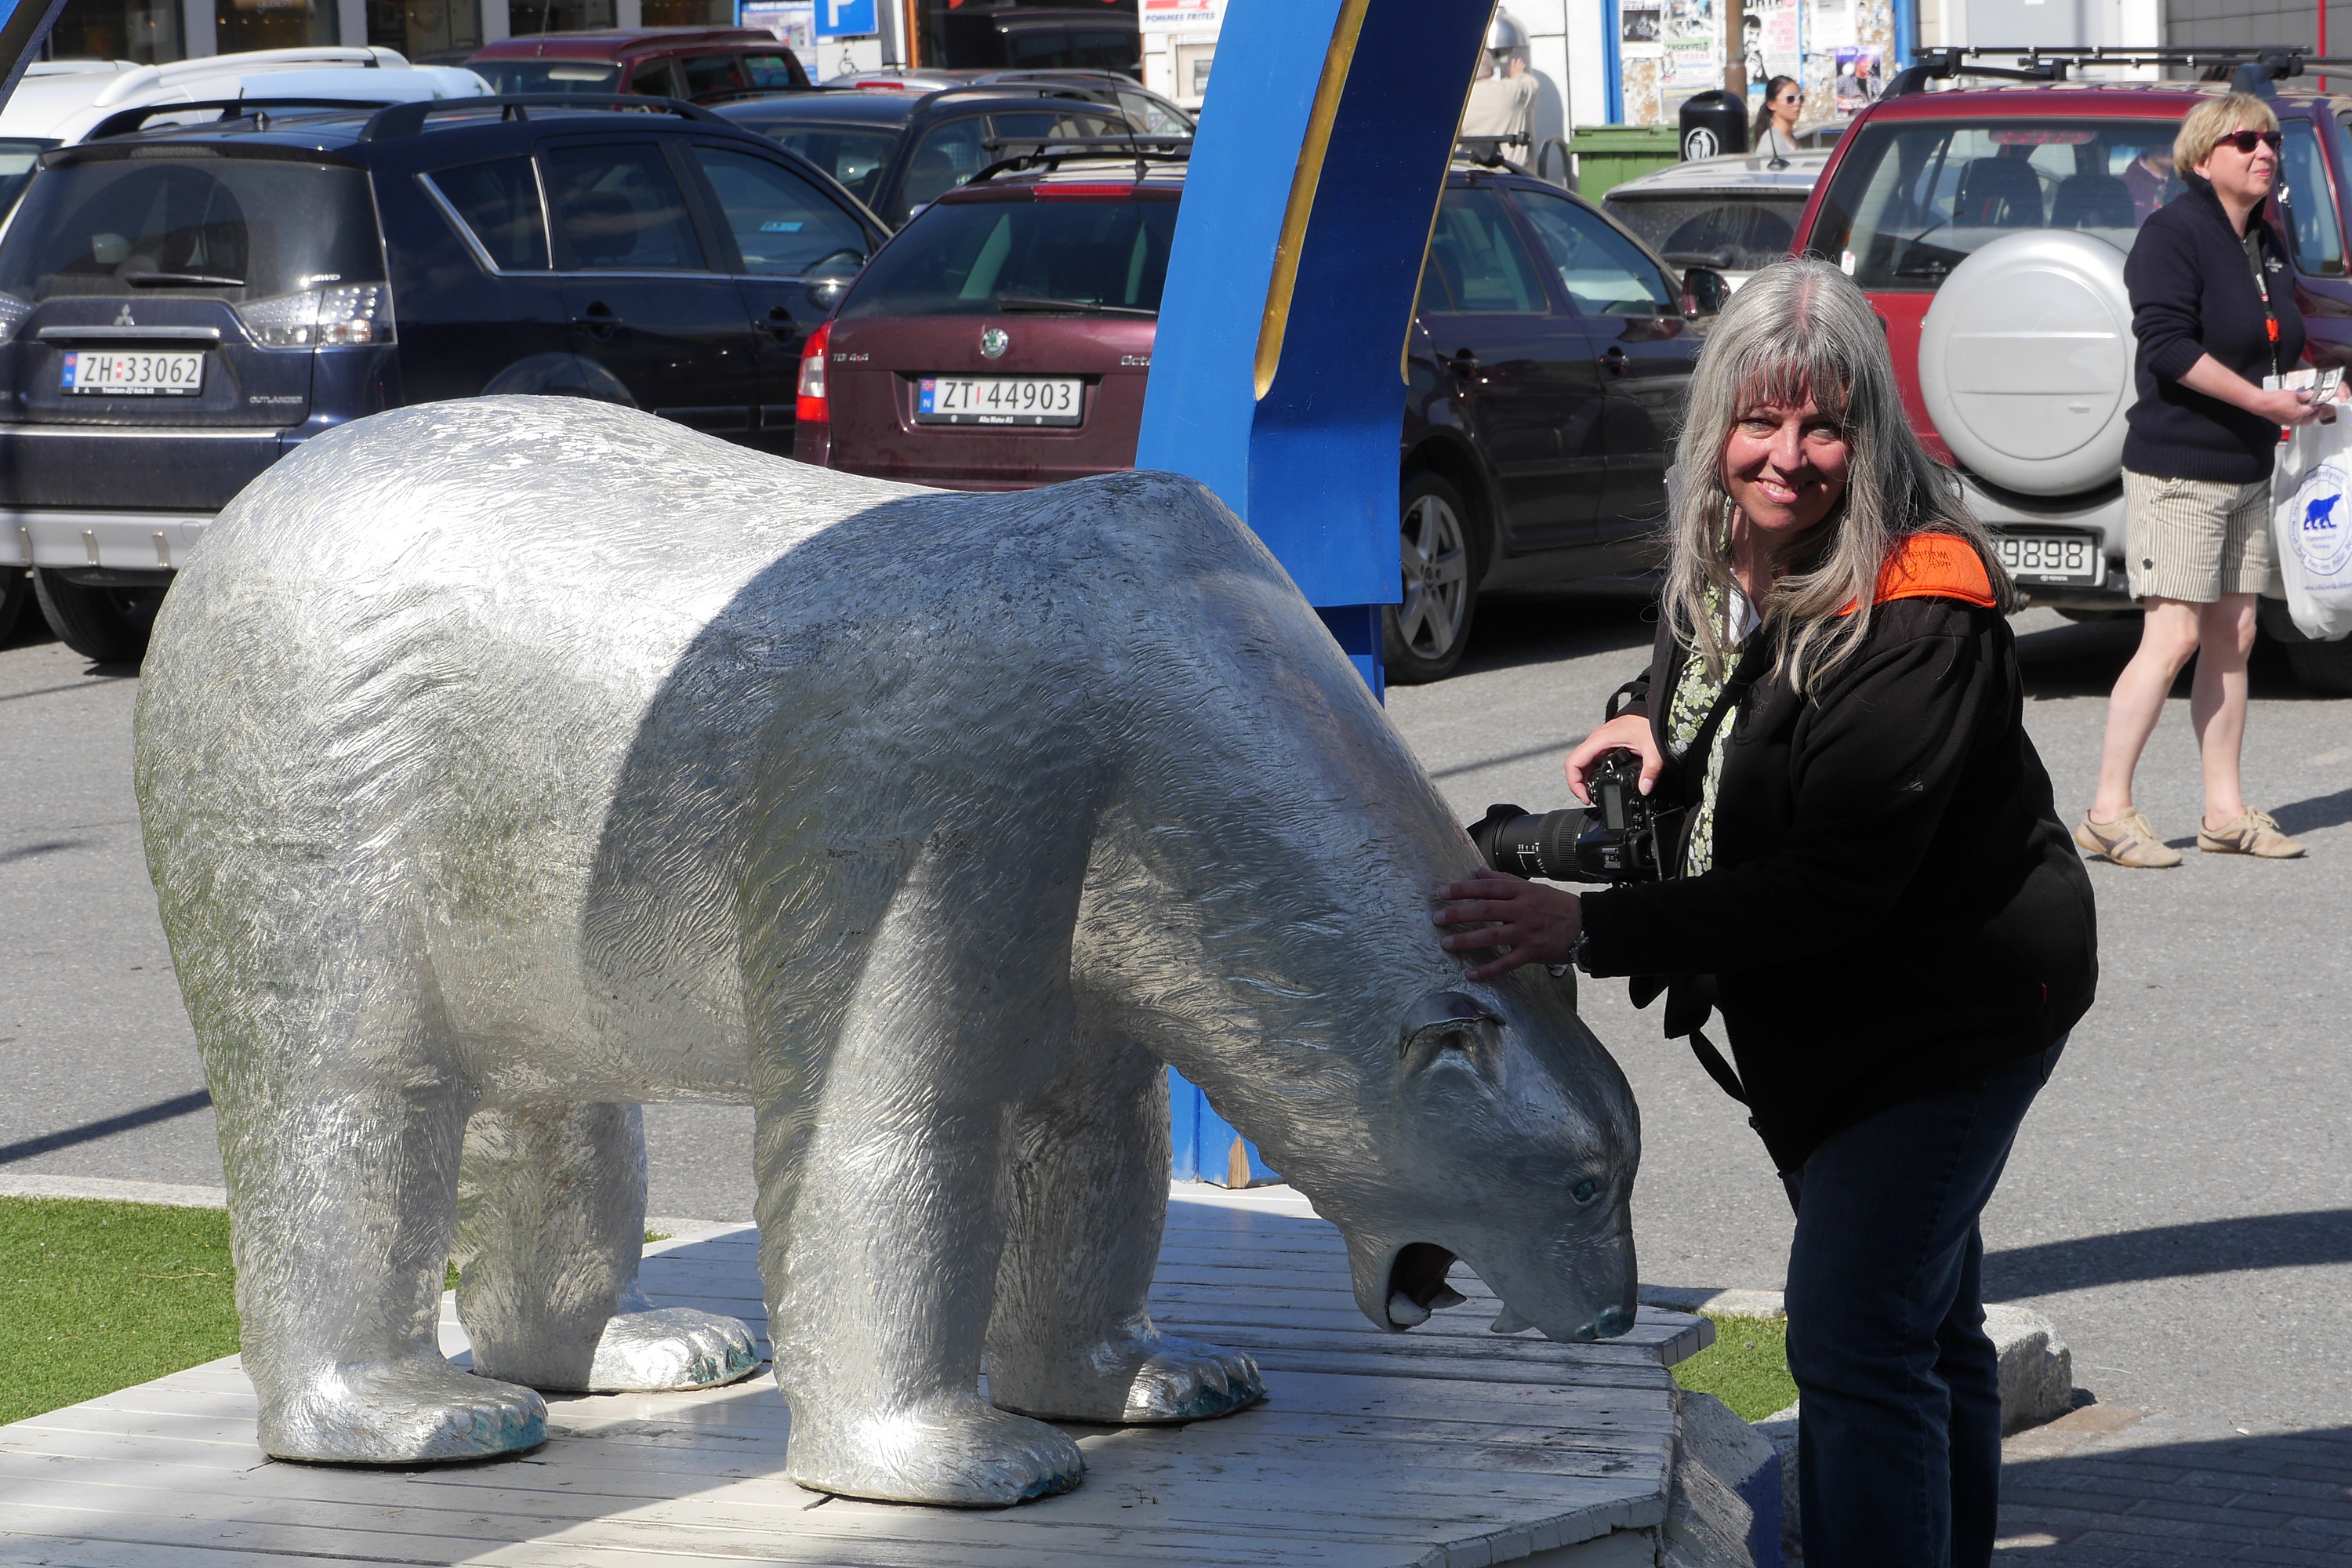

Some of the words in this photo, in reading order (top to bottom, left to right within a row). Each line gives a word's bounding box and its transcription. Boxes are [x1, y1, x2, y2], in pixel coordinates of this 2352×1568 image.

[1145, 13, 1184, 22] POMMES
[1187, 12, 1215, 20] FRITES
[84, 357, 113, 383] ZH
[125, 357, 198, 383] 33062
[66, 373, 73, 382] N
[943, 382, 973, 408] ZT
[987, 383, 1071, 410] 44903
[923, 398, 931, 408] N
